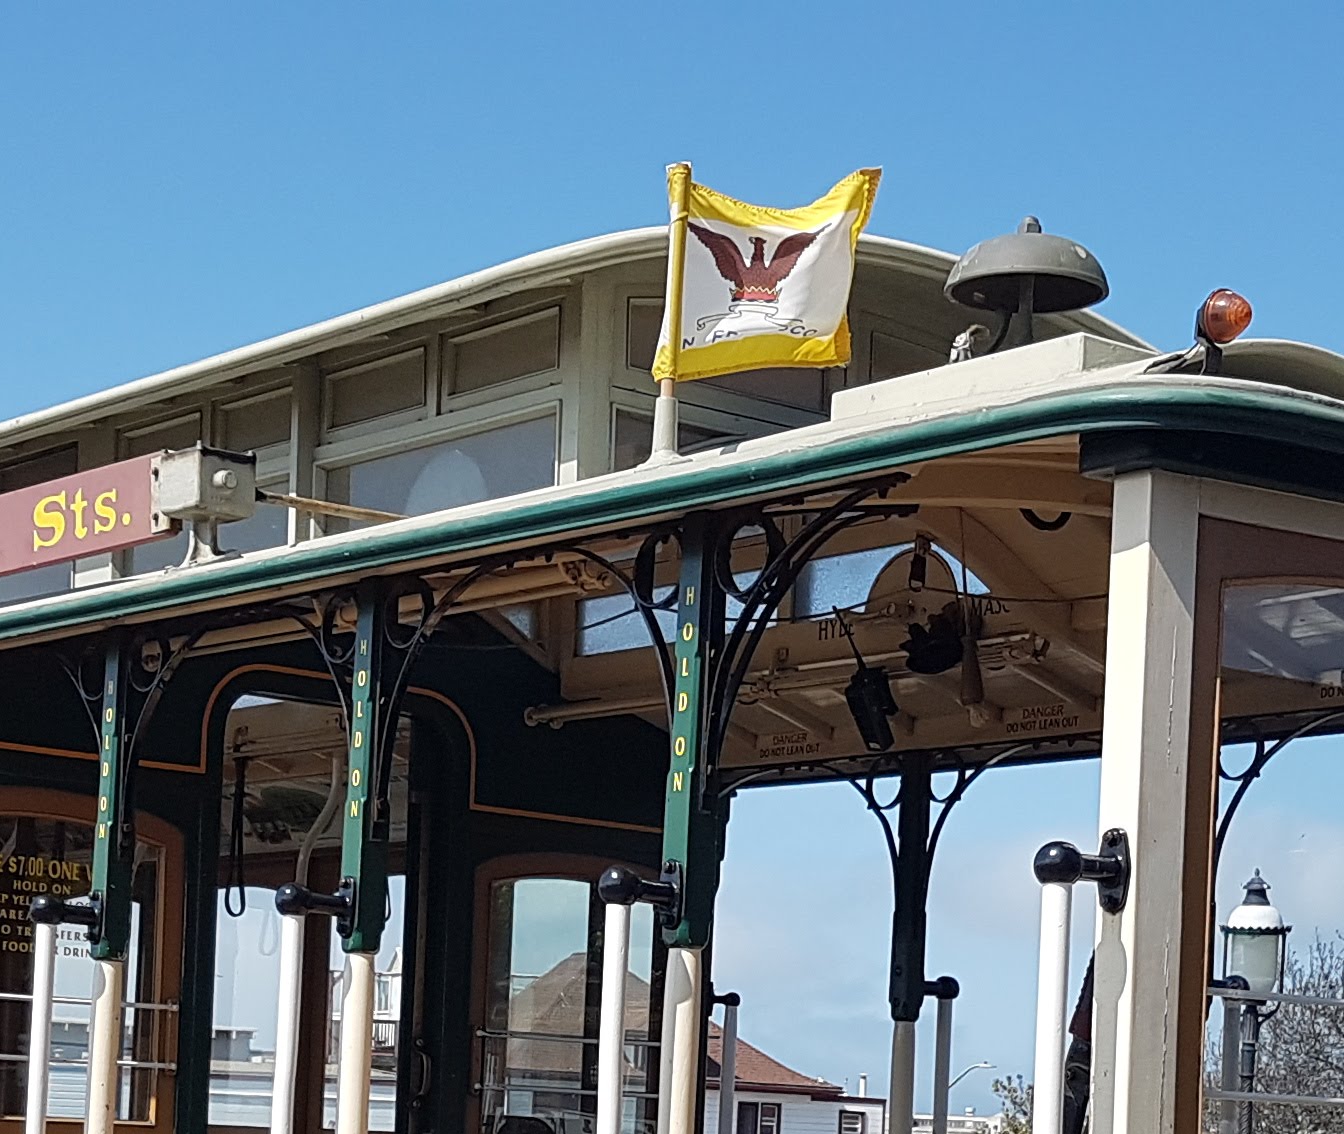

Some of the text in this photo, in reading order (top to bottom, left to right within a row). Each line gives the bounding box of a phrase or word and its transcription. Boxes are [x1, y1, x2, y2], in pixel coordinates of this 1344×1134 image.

[32, 487, 132, 552] Sts.
[1022, 704, 1065, 719] DANGER
[1006, 716, 1079, 734] DO NOT LEAN OUT
[772, 732, 808, 745] DANGER
[48, 860, 80, 881] ONE
[13, 880, 71, 895] HOLD ON
